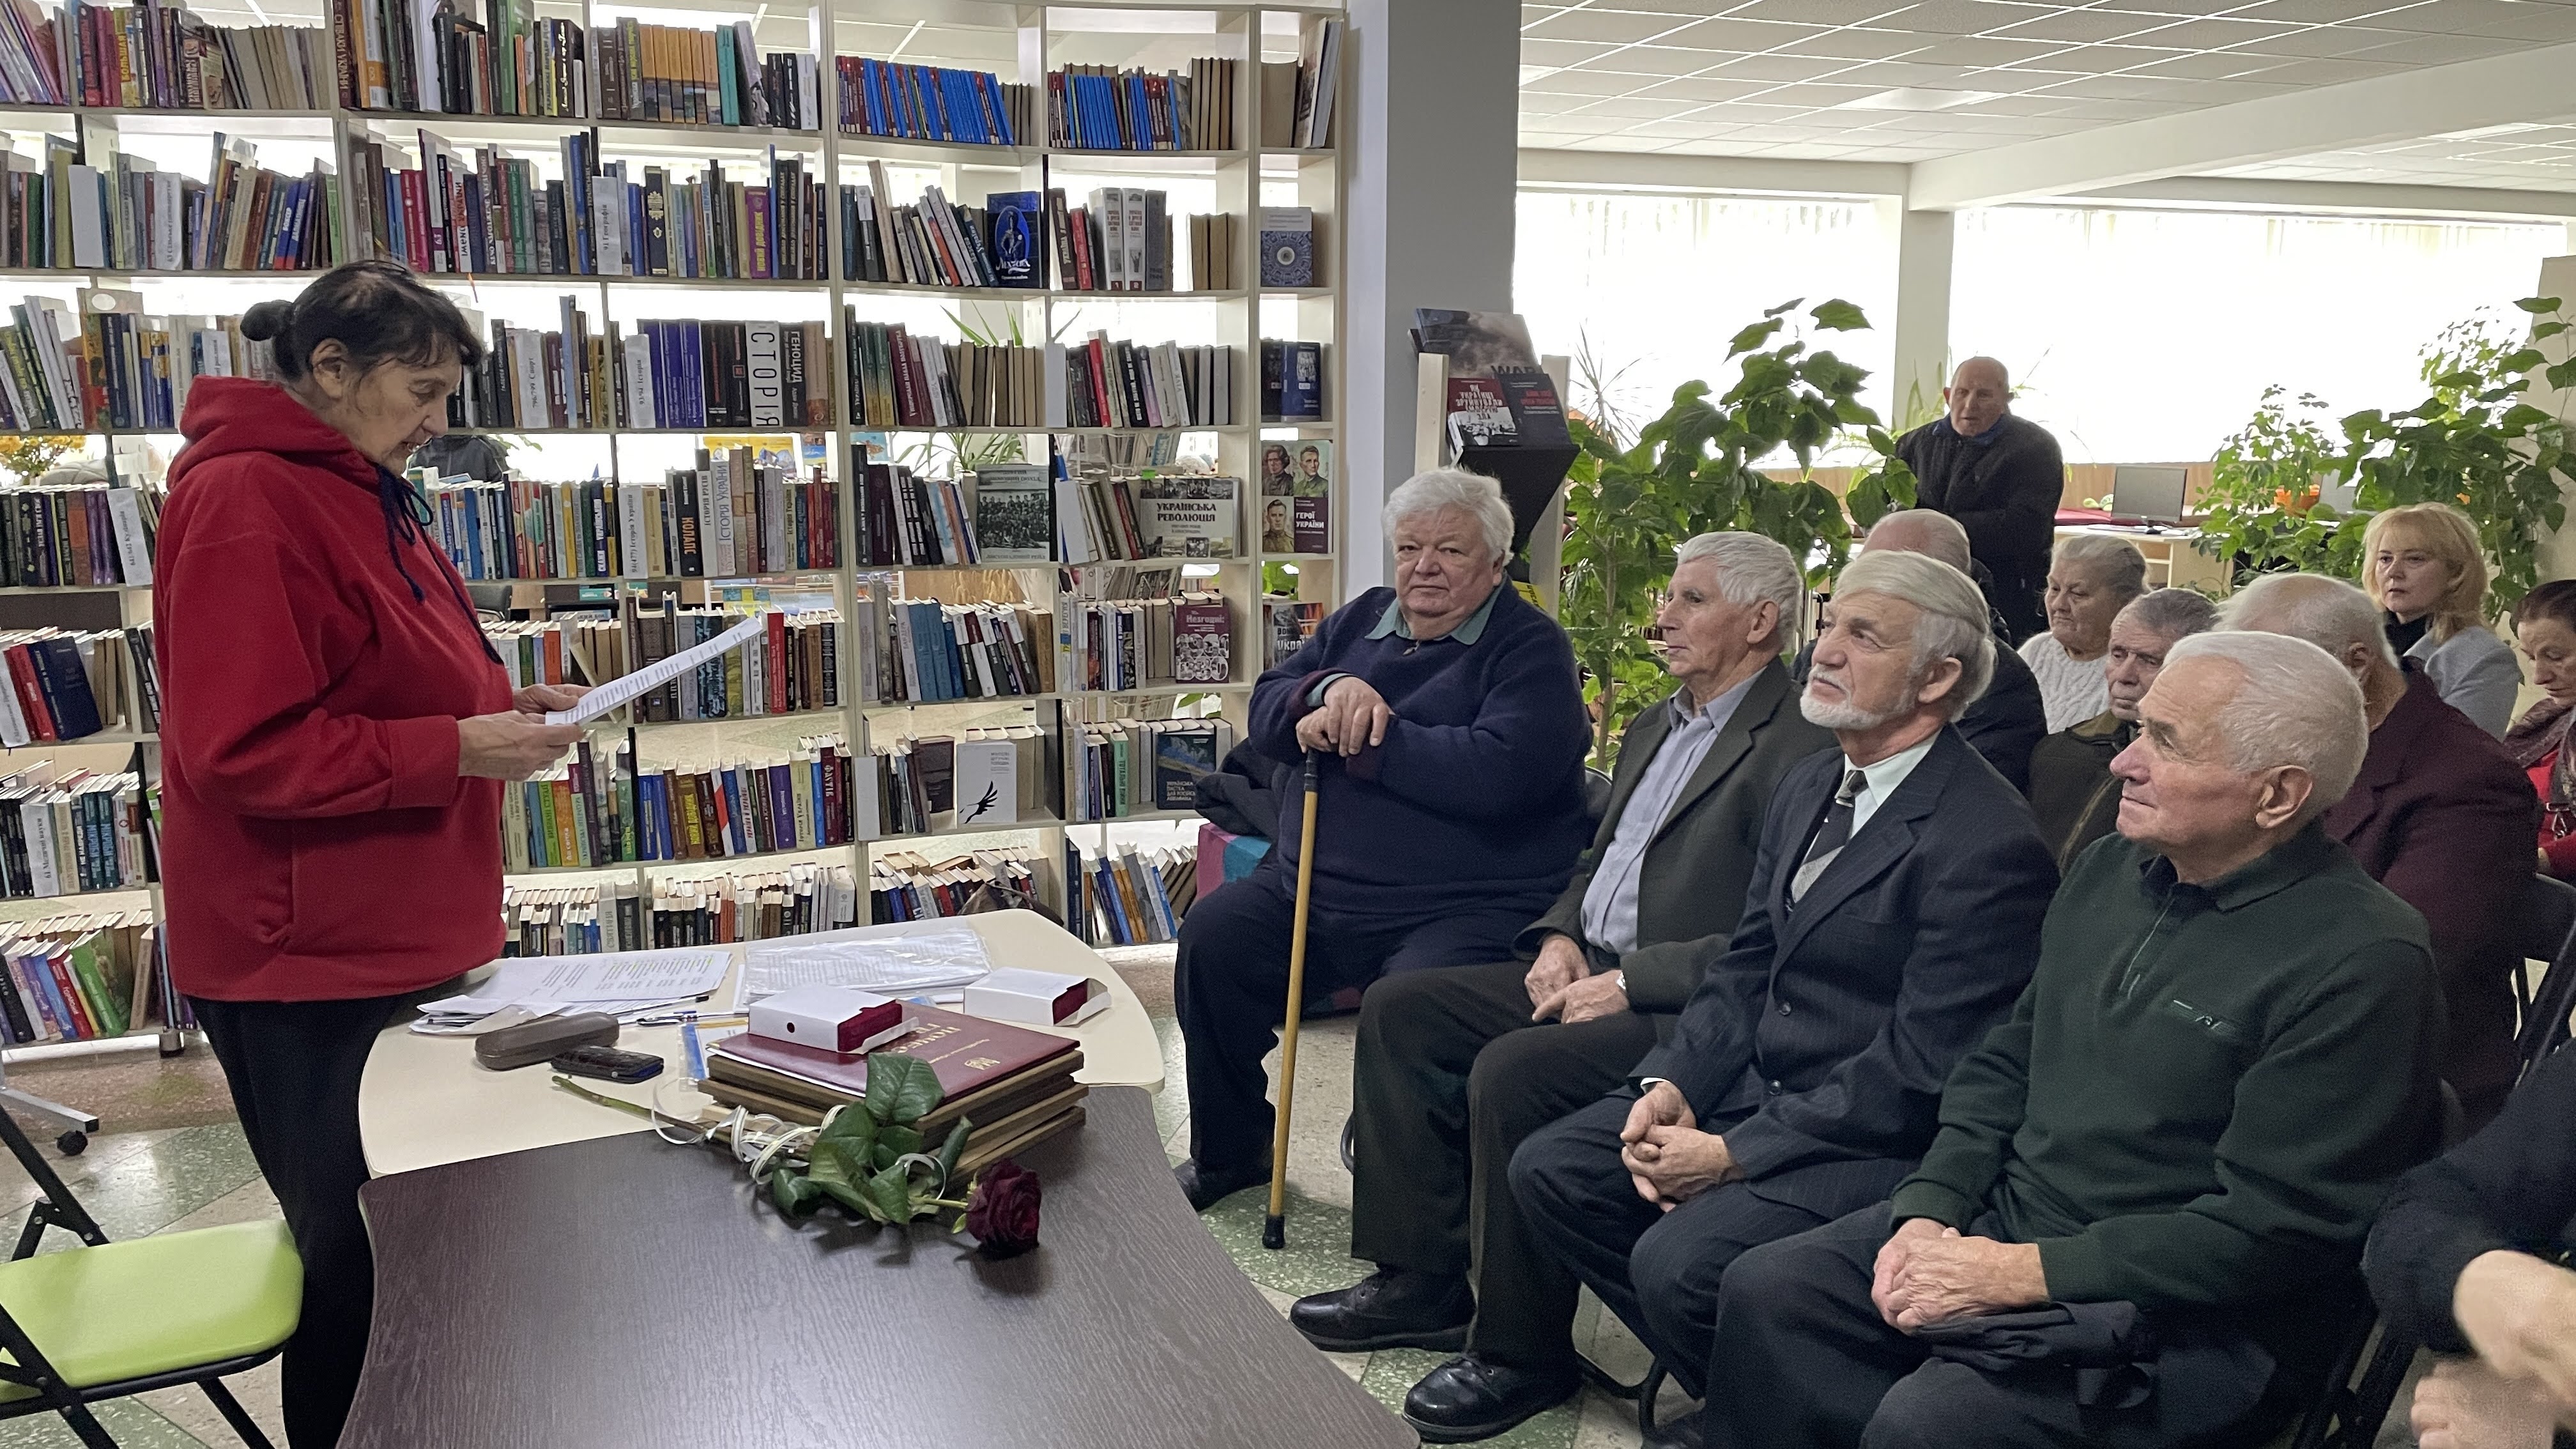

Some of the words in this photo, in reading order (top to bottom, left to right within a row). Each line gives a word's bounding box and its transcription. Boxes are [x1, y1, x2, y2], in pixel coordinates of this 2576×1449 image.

[334, 14, 346, 52] СПІВАКИ
[337, 54, 348, 89] УКРАЇНИ
[601, 204, 610, 240] Географія
[754, 211, 766, 247] ДОВІДНИК
[754, 247, 766, 272] НОВИЙ
[790, 331, 802, 383] ГЕНОЦИД
[701, 475, 709, 496] РУСІВ
[716, 464, 729, 502] УКРАЇНИ
[627, 494, 636, 522] України
[702, 498, 711, 526] ІСТОРІЯ
[1156, 502, 1216, 512] УКРАЇНСЬКА
[1157, 513, 1216, 522] РЕВОЛЮЦІЯ
[1296, 511, 1315, 519] ГЕРОЇ
[629, 524, 637, 548] Історія
[681, 517, 697, 555] КОЛАПС
[718, 504, 732, 541] ІСТОРІЯ
[1296, 519, 1324, 528] УКРАЇНИ
[1186, 615, 1225, 624] Незгодні:
[684, 793, 699, 824] ДОВІДНИК
[36, 818, 46, 840] науки
[86, 824, 100, 858] МІКРОБИ
[100, 823, 113, 856] МІКРОБИ
[687, 824, 701, 845] НОВИЙ
